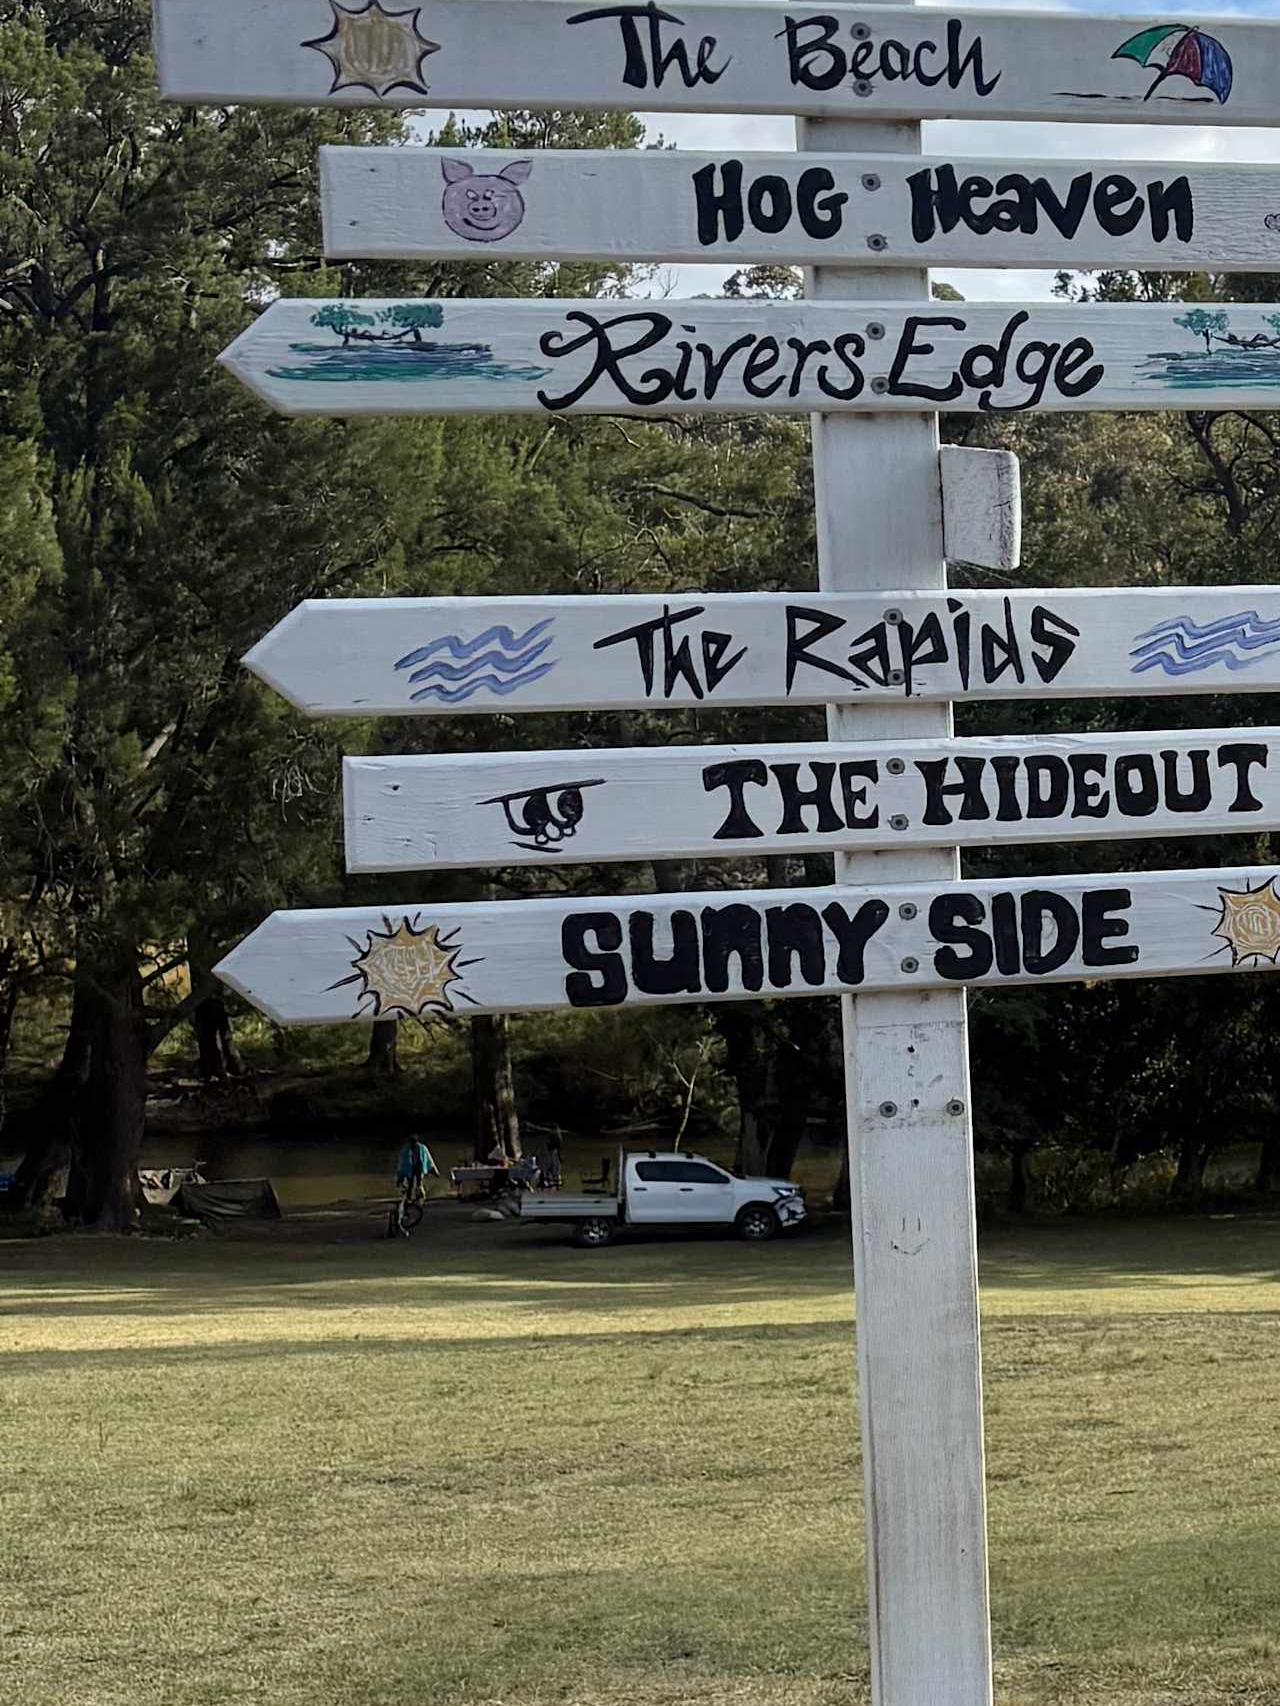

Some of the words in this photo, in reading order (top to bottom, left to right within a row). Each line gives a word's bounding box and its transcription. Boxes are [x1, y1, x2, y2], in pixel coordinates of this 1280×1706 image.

[564, 0, 732, 90] The
[773, 14, 1002, 97] Beach
[692, 159, 850, 246] HOG
[536, 310, 867, 410] Rivers
[887, 310, 1105, 412] Edge
[593, 604, 749, 700] The
[785, 596, 1081, 698] Rapids
[702, 759, 881, 840] THE
[913, 743, 1269, 826] HIDEOUT
[928, 888, 1140, 981] SIDE
